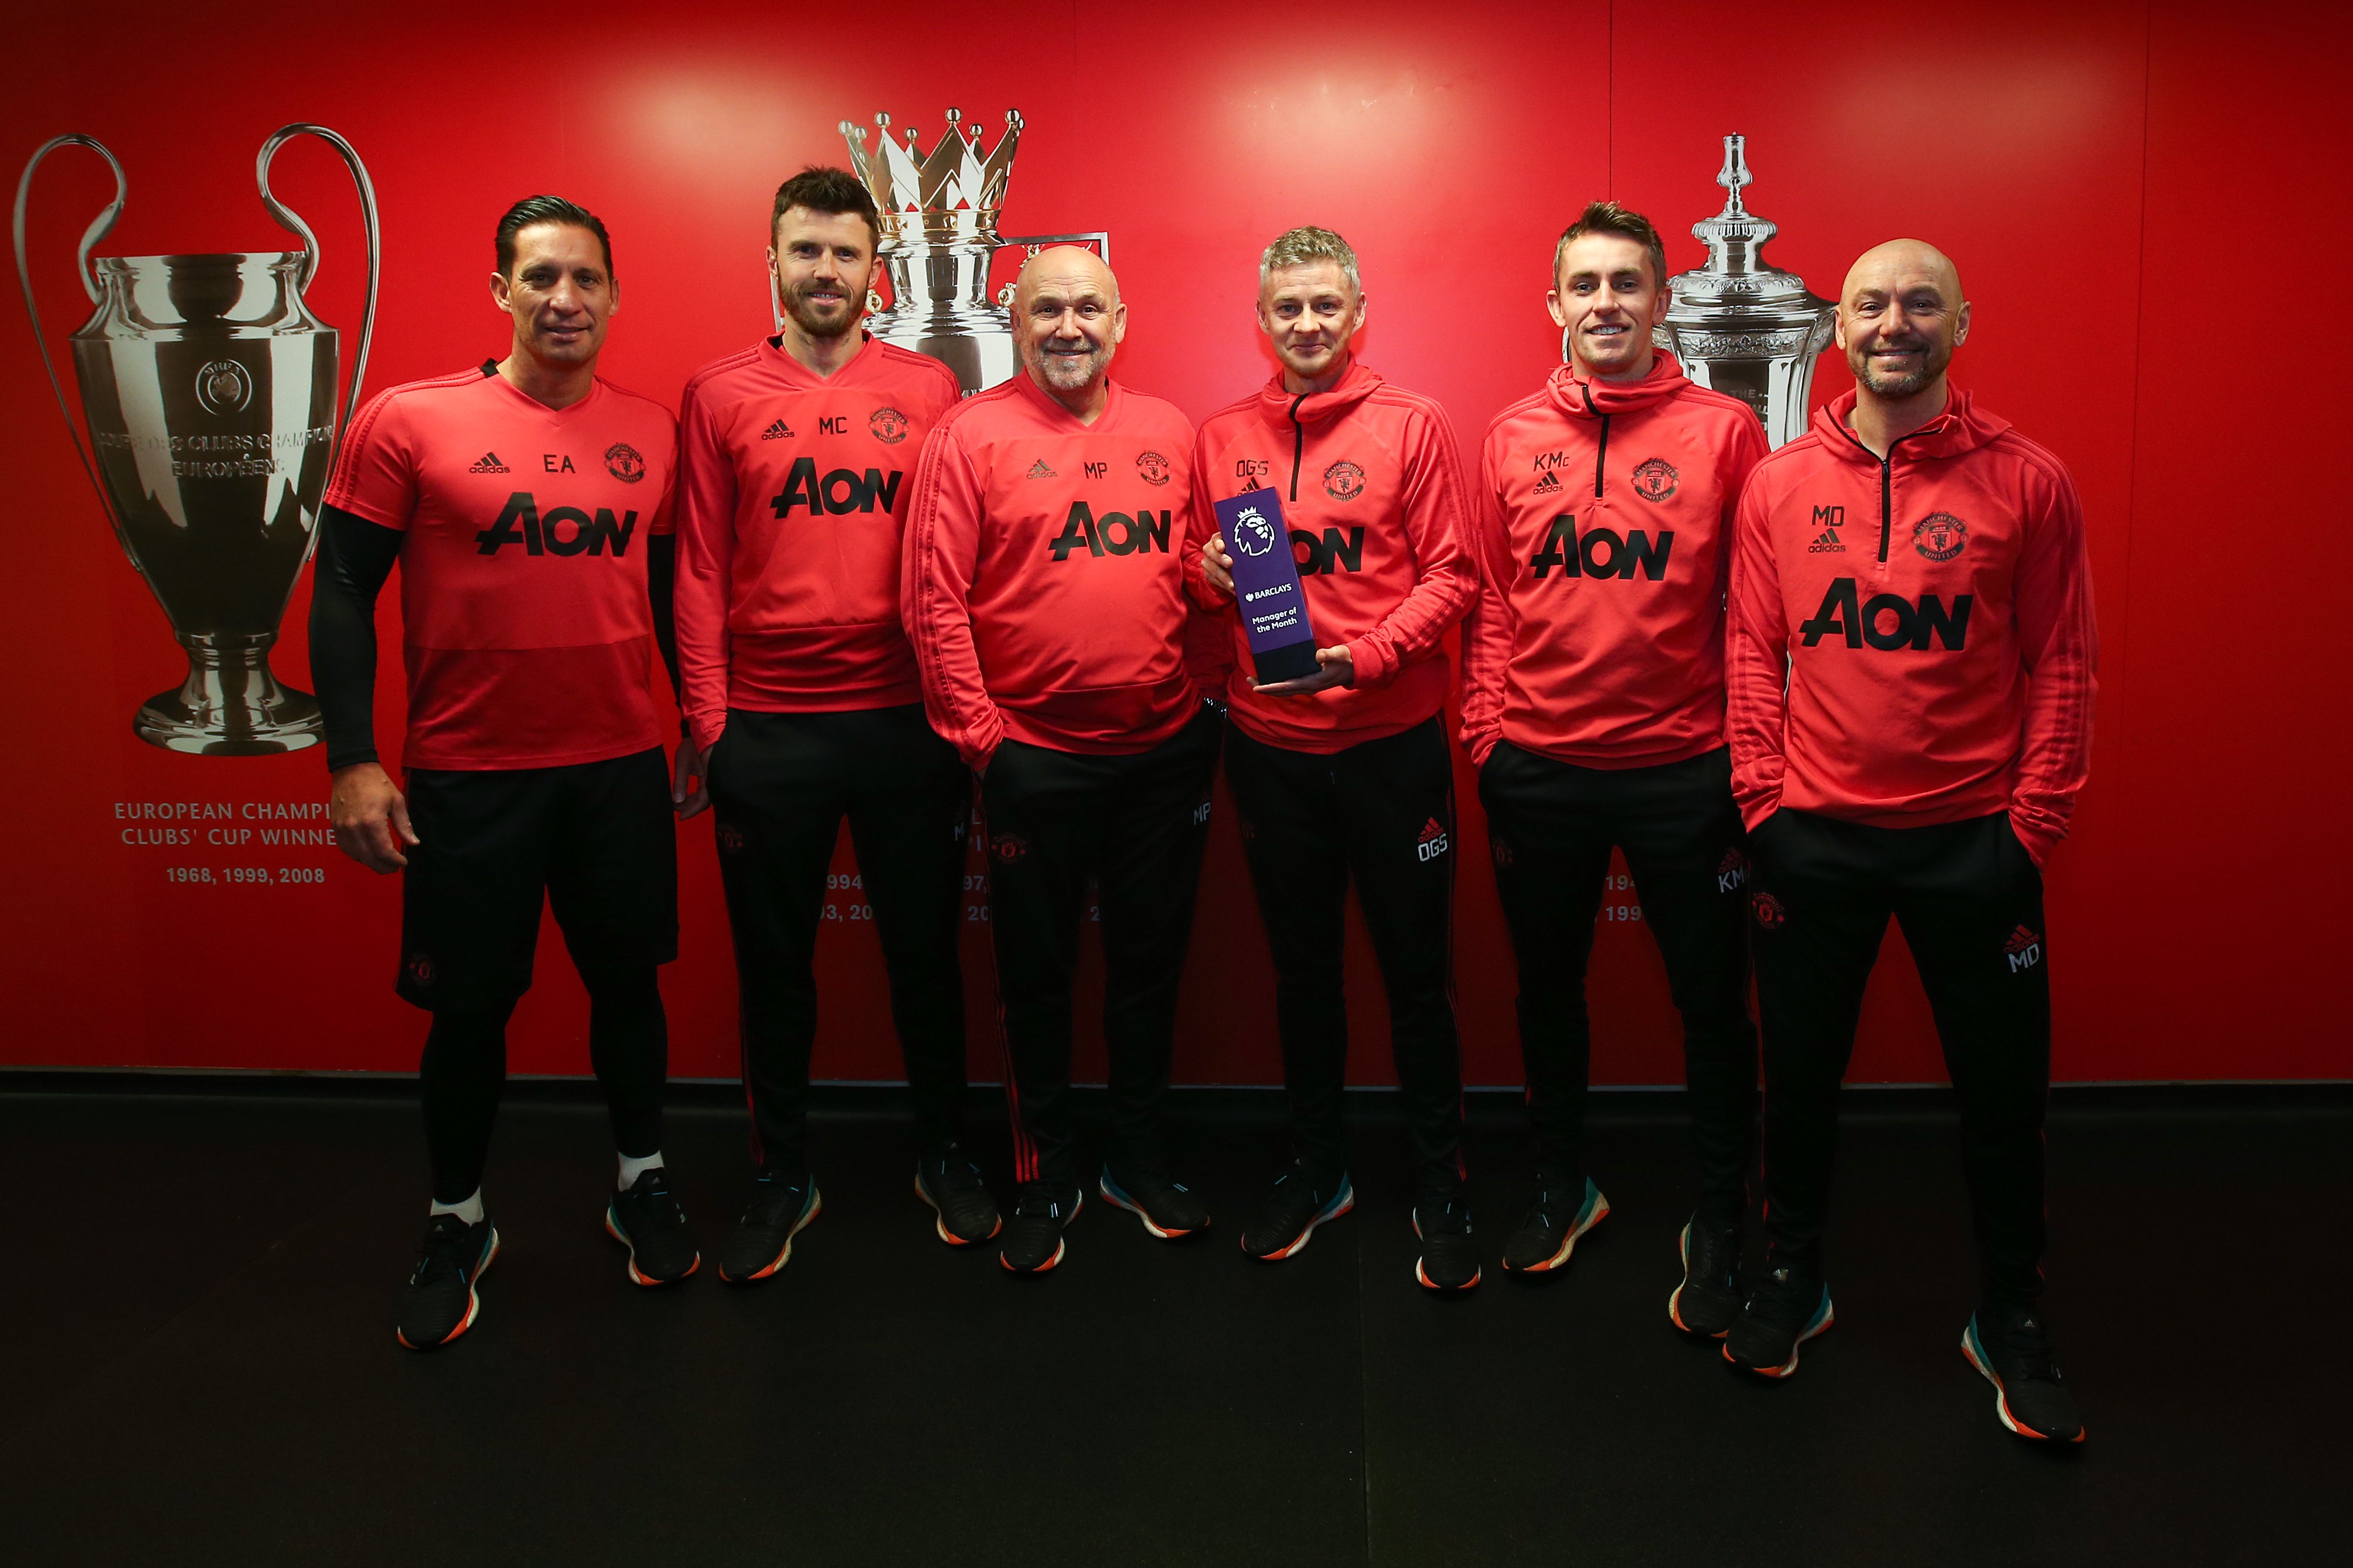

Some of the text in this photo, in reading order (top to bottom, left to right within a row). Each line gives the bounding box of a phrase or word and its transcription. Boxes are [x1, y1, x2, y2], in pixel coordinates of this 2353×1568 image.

[819, 417, 847, 435] MC
[761, 431, 795, 440] adidas
[469, 465, 510, 473] adidas
[544, 454, 576, 473] EA
[1084, 462, 1108, 479] MP
[1236, 459, 1269, 478] OGS
[1327, 463, 1362, 477] MANCHESTER
[1637, 462, 1675, 476] MANCHESTER
[770, 457, 903, 519] AON
[1333, 491, 1358, 499] UNITED
[1533, 485, 1564, 495] adidas
[1642, 492, 1669, 500] UNITED
[474, 492, 638, 557] AON
[1811, 505, 1844, 527] MD
[1917, 515, 1963, 532] MANCHESTER
[1048, 501, 1171, 562] AON
[1291, 527, 1364, 577] ON
[1529, 514, 1675, 581] AON
[1808, 543, 1845, 553] adidas
[1925, 550, 1957, 559] UNITED
[1255, 583, 1292, 599] BARCLAYS
[1252, 606, 1298, 625] Manager of
[1799, 577, 1973, 651] AON
[1256, 617, 1298, 633] the Month
[114, 803, 331, 819] EUROPEAN CHAMPI
[1193, 802, 1211, 826] MP
[121, 829, 337, 845] CLUBS' CUP WINNE
[1418, 827, 1445, 843] adidas
[1418, 833, 1448, 862] OGS
[166, 867, 325, 885] 1968, 1999, 2008
[826, 874, 987, 894] 994 97,
[1718, 864, 1750, 893] KM
[850, 905, 873, 920] 20
[968, 905, 989, 921] 20
[1606, 906, 1642, 921] 199
[2008, 943, 2039, 973] MD
